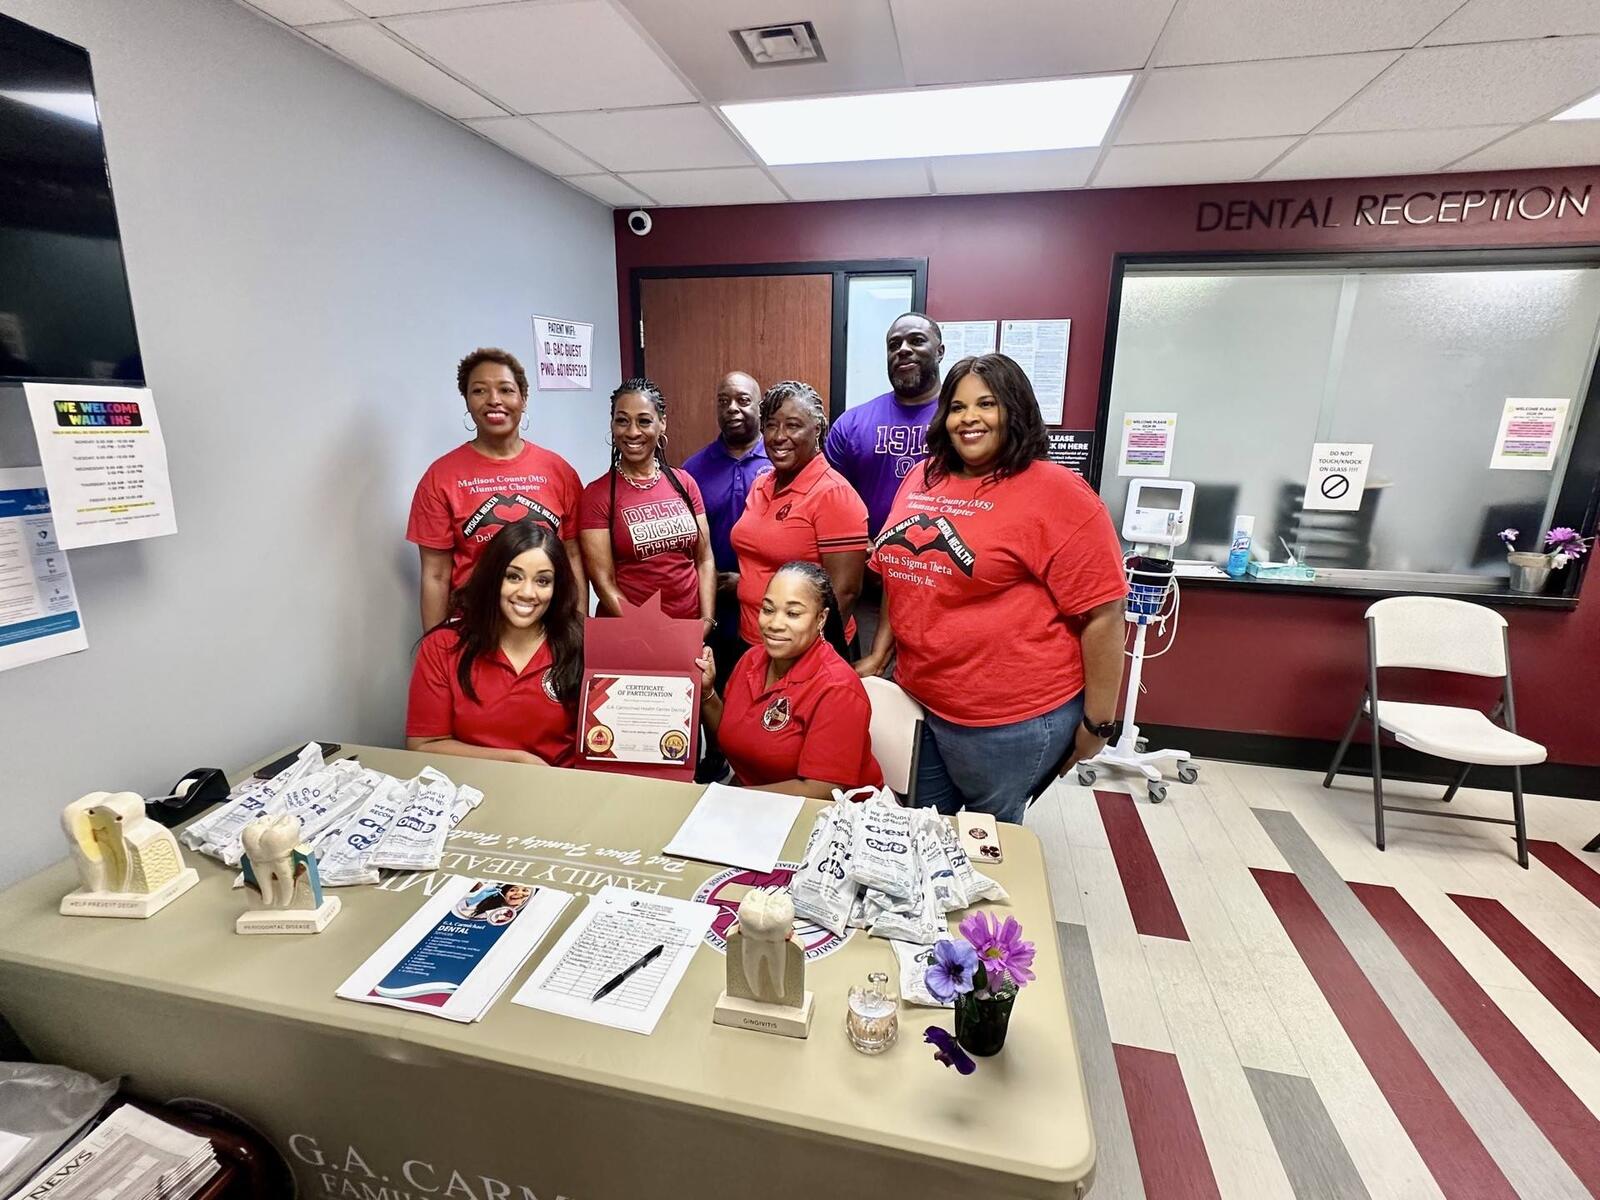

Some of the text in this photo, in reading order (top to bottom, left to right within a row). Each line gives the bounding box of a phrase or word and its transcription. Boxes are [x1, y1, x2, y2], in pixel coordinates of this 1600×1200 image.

[1195, 184, 1593, 232] DENTAL RECEPTION
[565, 343, 582, 357] GUEST
[56, 402, 139, 414] WE WELCOME
[68, 414, 132, 425] WALK INS
[1057, 442, 1067, 450] IN
[1067, 442, 1089, 450] HERE
[457, 475, 548, 488] Madison County (MS)
[469, 483, 541, 495] Alumnae Chapter
[515, 494, 541, 513] MENTAL
[936, 495, 968, 508] County
[968, 499, 995, 511] (MS)
[940, 504, 976, 517] Chapter
[464, 494, 499, 536] PHYSICAL HEALTH
[624, 500, 689, 525] DELTA
[632, 517, 697, 542] SIGMA
[895, 514, 921, 533] HEALTH
[947, 537, 976, 567] HEALTH
[878, 552, 953, 576] Delta Sigma Theta
[888, 568, 924, 586] Sorority,
[627, 690, 673, 698] PARTICIPATION
[433, 850, 532, 878] HEAL
[437, 925, 470, 935] DENTAL
[743, 1017, 778, 1029] GINGIVITIS
[288, 1133, 389, 1182] G.A.
[30, 1149, 94, 1200] NEWS
